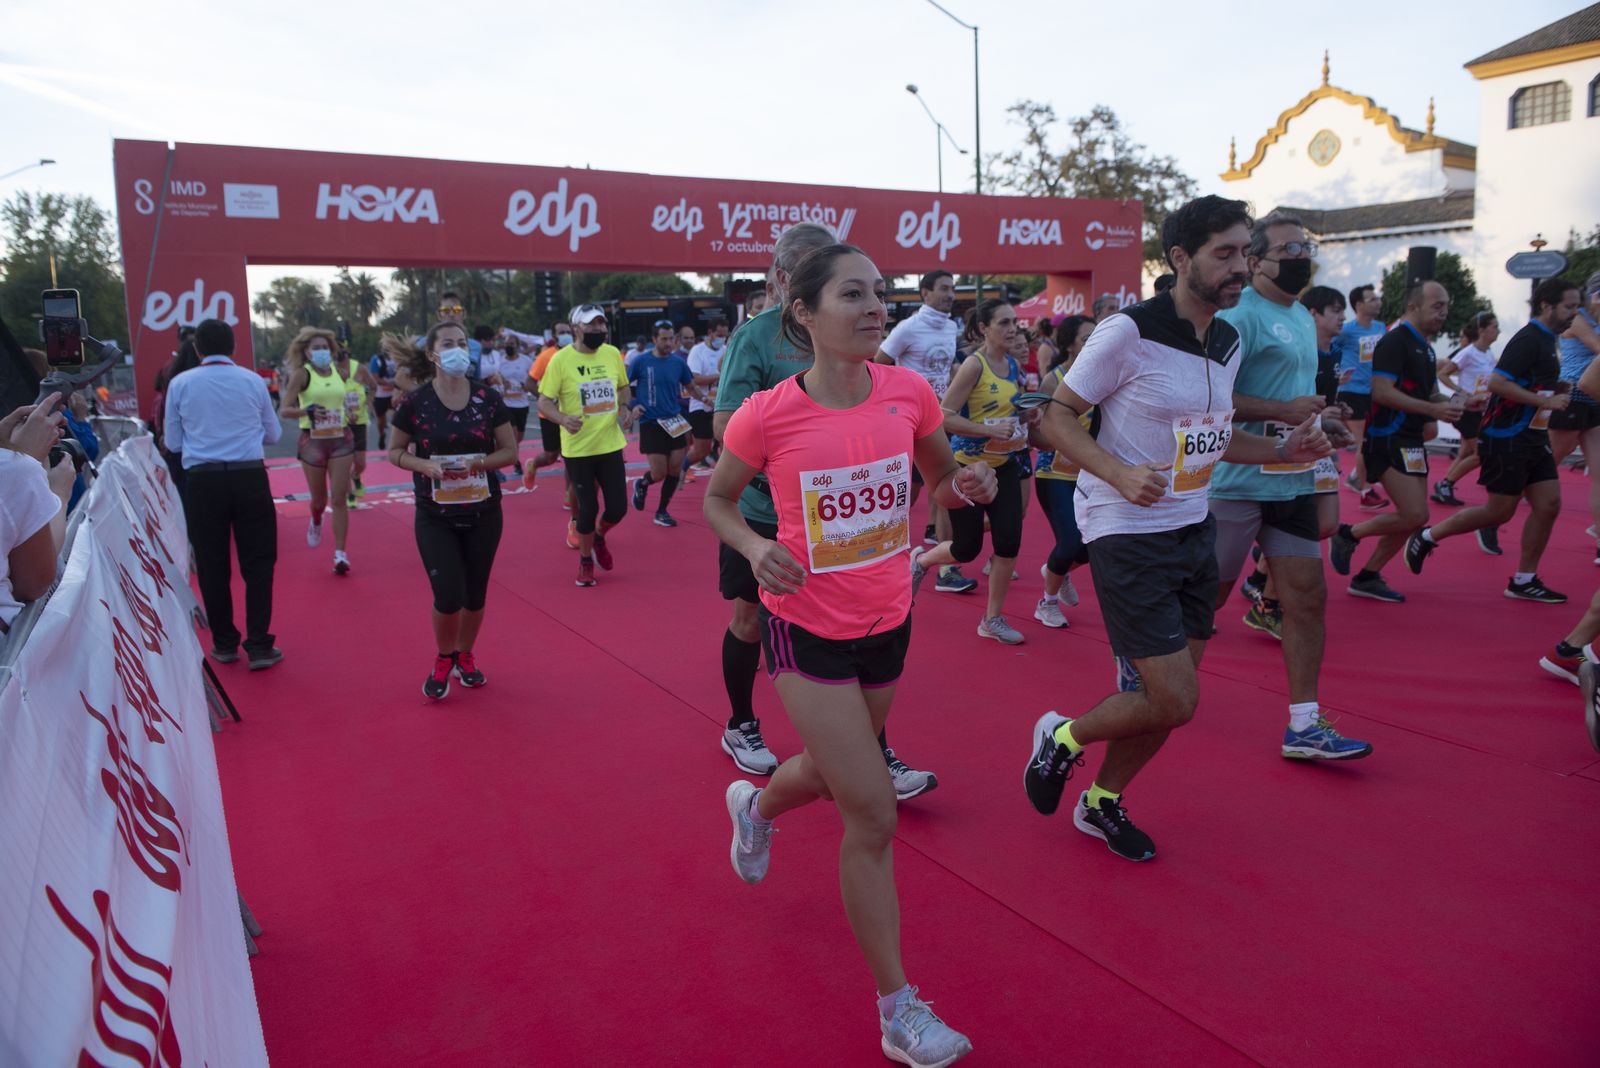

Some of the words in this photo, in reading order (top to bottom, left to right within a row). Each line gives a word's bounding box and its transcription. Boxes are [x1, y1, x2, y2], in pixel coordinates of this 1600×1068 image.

[171, 180, 206, 197] IMD
[315, 182, 440, 224] HOKA
[503, 177, 601, 253] edp
[745, 202, 837, 224] maratón
[651, 197, 704, 241] edp
[895, 199, 962, 262] edp
[998, 218, 1062, 246] HOKA
[710, 240, 723, 252] 17
[727, 241, 776, 253] octubre
[585, 387, 610, 400] 5126
[1184, 429, 1226, 456] 6625
[812, 474, 832, 488] edp
[851, 468, 870, 481] edp
[886, 460, 902, 473] edp
[817, 483, 896, 522] 6939
